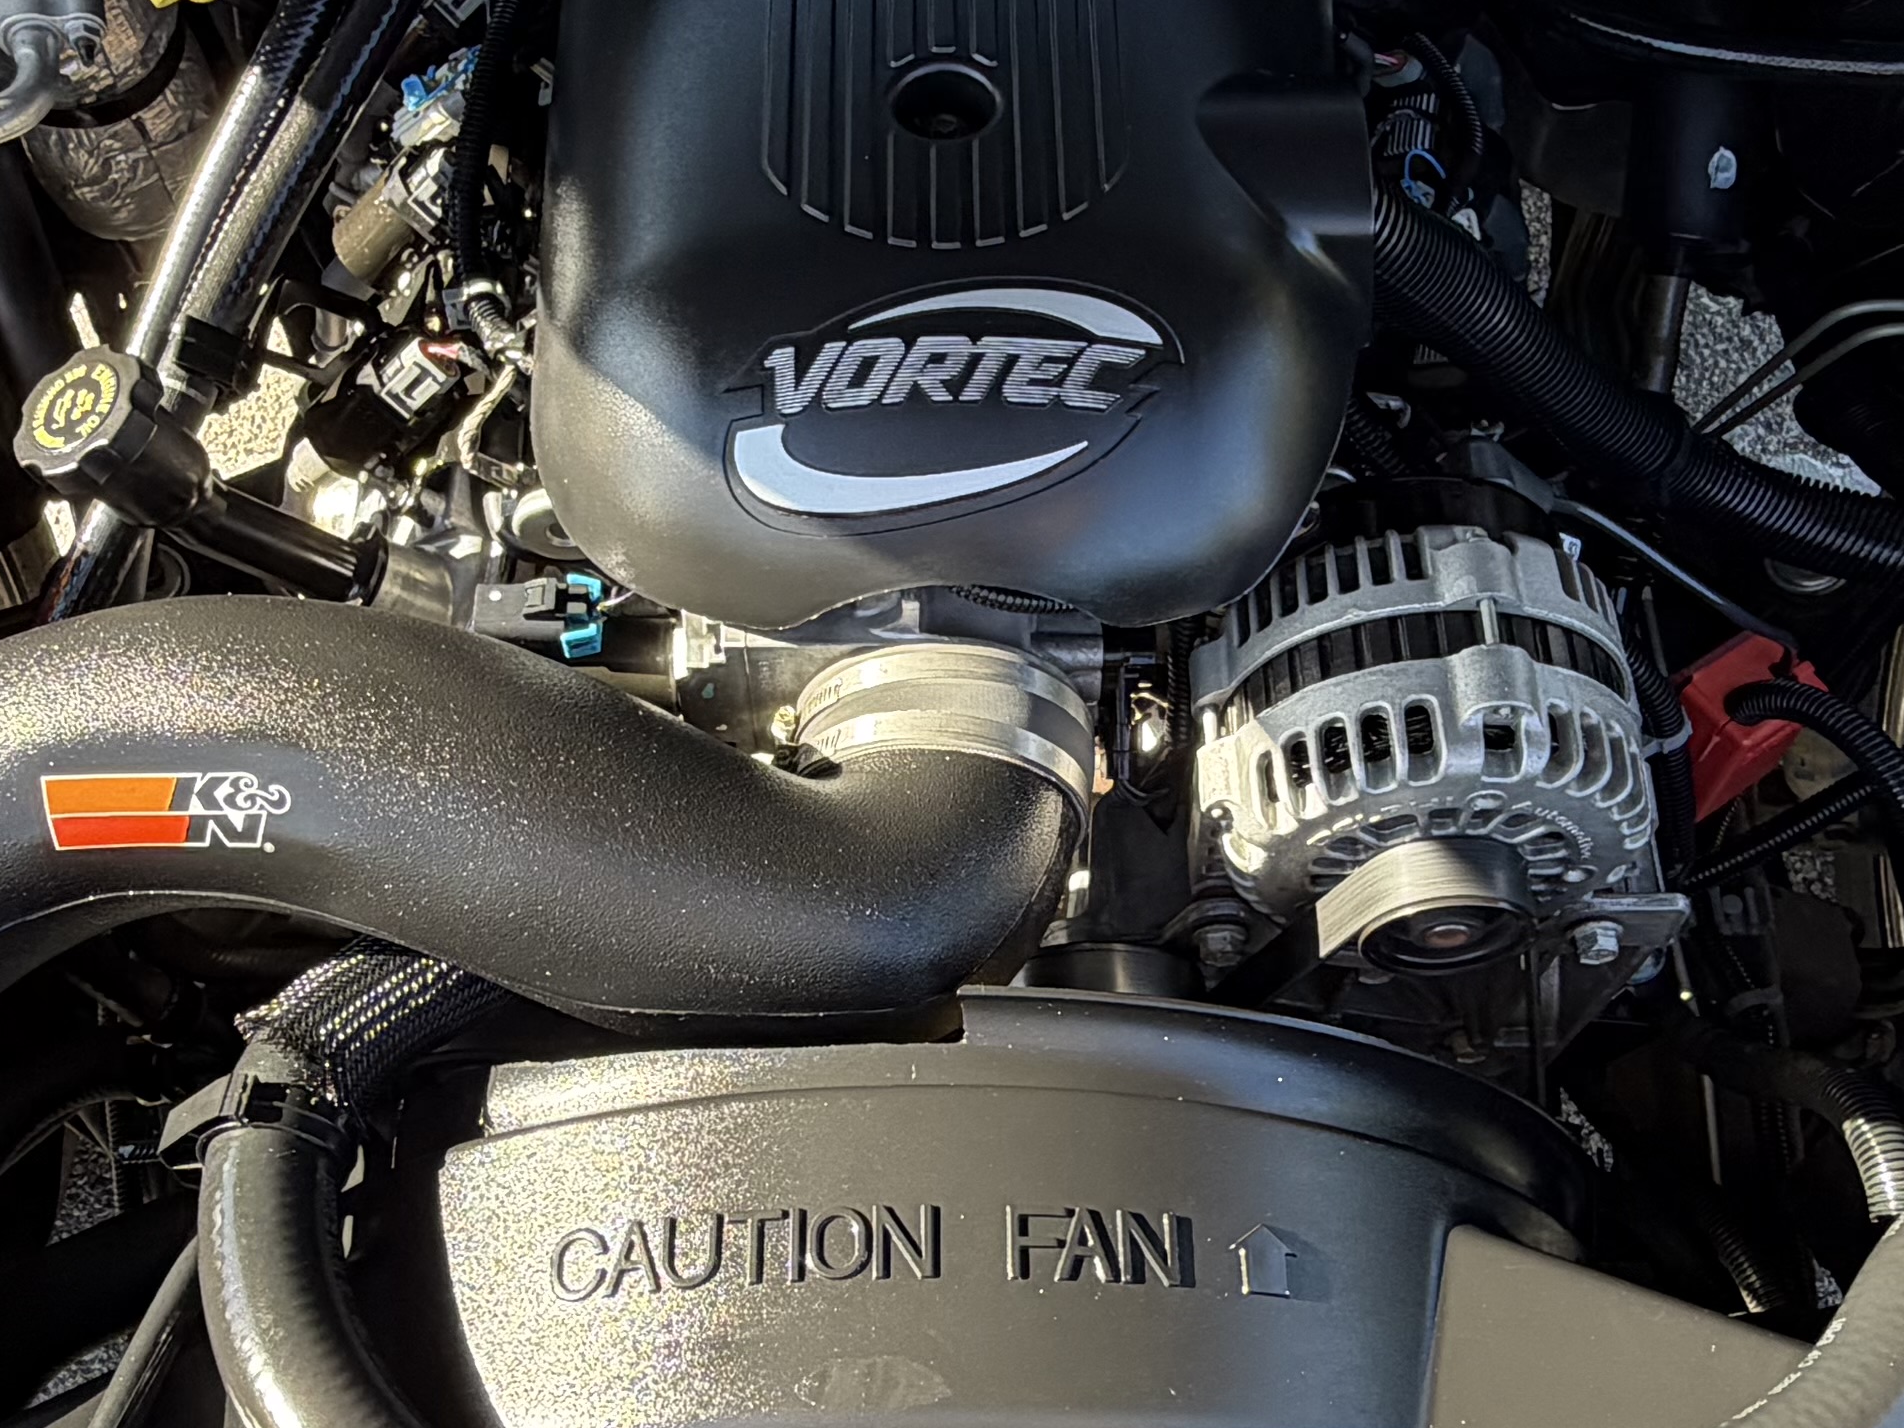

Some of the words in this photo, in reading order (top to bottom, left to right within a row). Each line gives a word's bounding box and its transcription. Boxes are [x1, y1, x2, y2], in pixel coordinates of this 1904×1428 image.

[762, 334, 1146, 415] VORTEC
[75, 414, 101, 438] OIL
[174, 771, 291, 849] K&N
[550, 1203, 941, 1301] CAUTION
[1006, 1203, 1195, 1288] FAN
